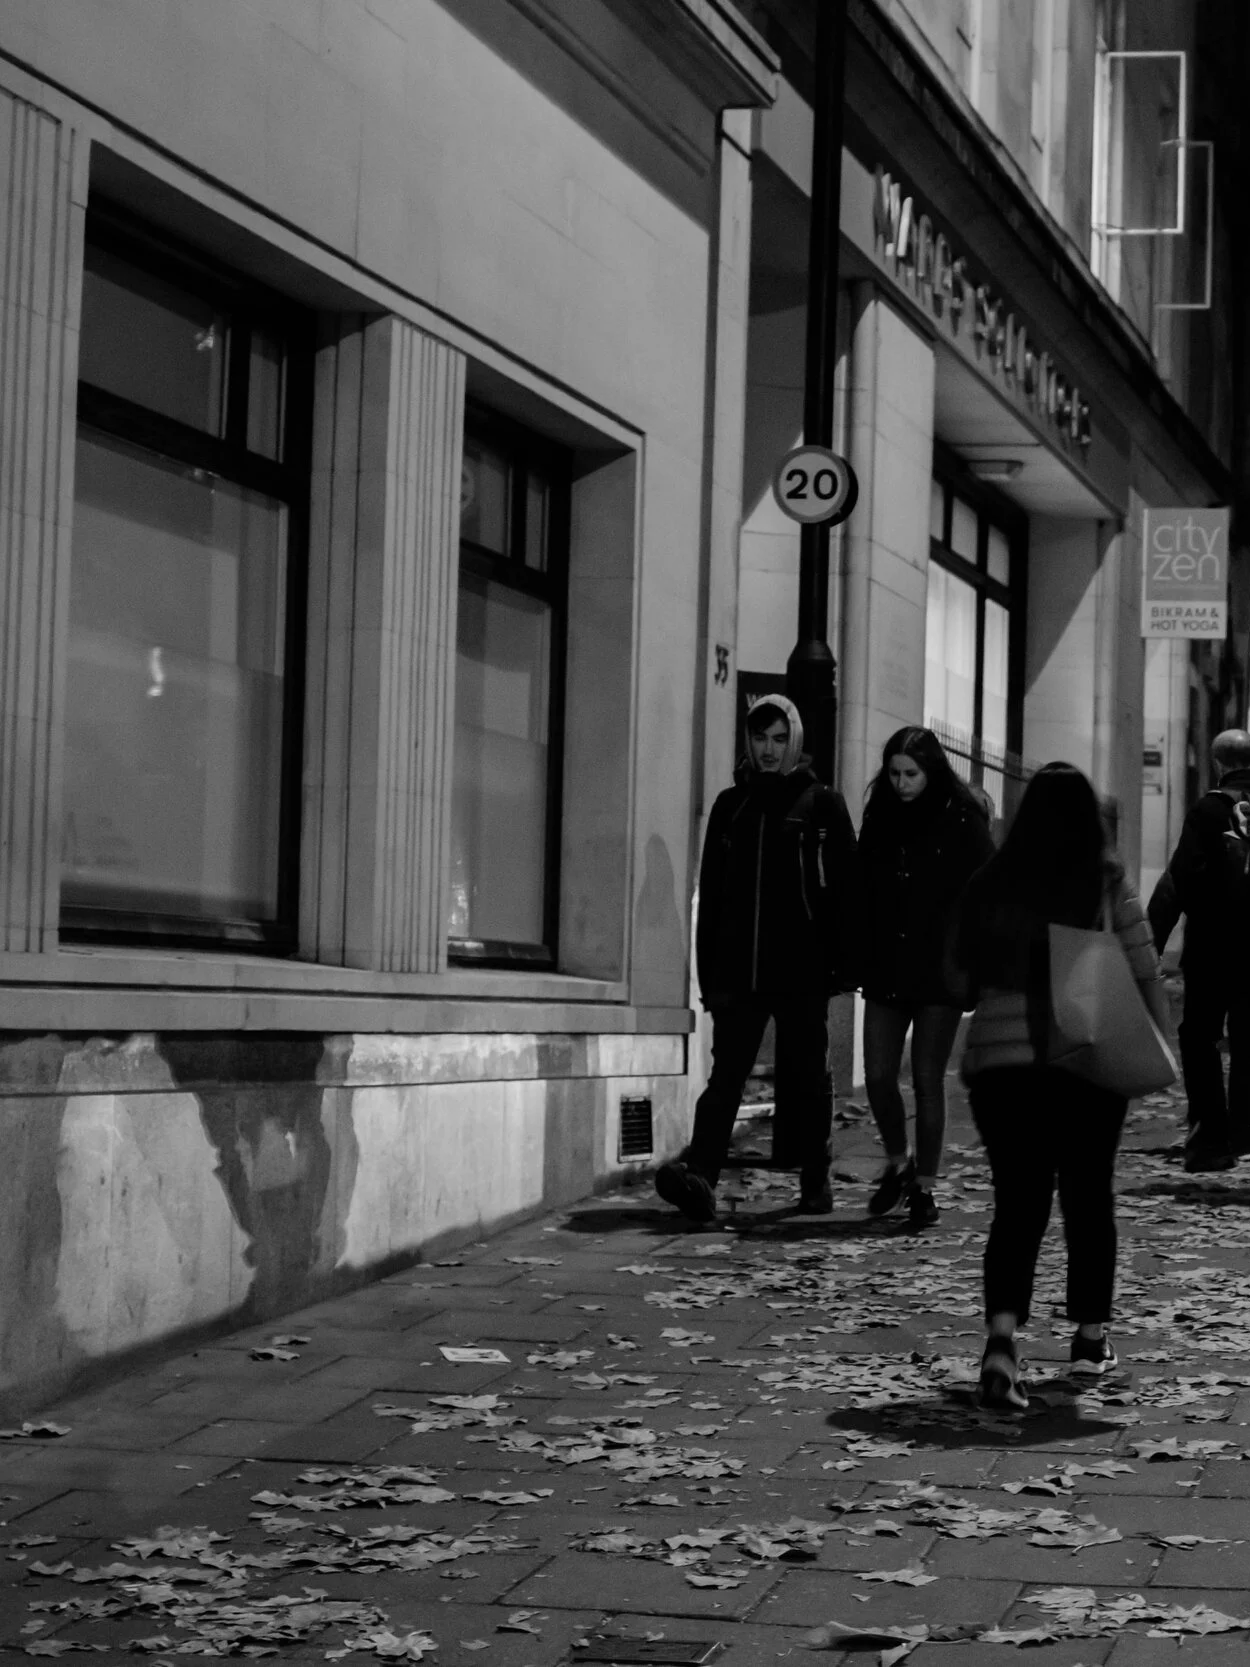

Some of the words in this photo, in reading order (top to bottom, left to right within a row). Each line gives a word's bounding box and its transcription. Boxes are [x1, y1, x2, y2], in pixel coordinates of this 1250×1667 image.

[786, 469, 838, 500] 20
[1153, 515, 1221, 556] city
[1152, 553, 1220, 581] zen
[1151, 606, 1207, 618] BIKRAM
[1210, 606, 1219, 618] &
[1151, 619, 1177, 631] HOT
[1182, 620, 1219, 631] YOGA
